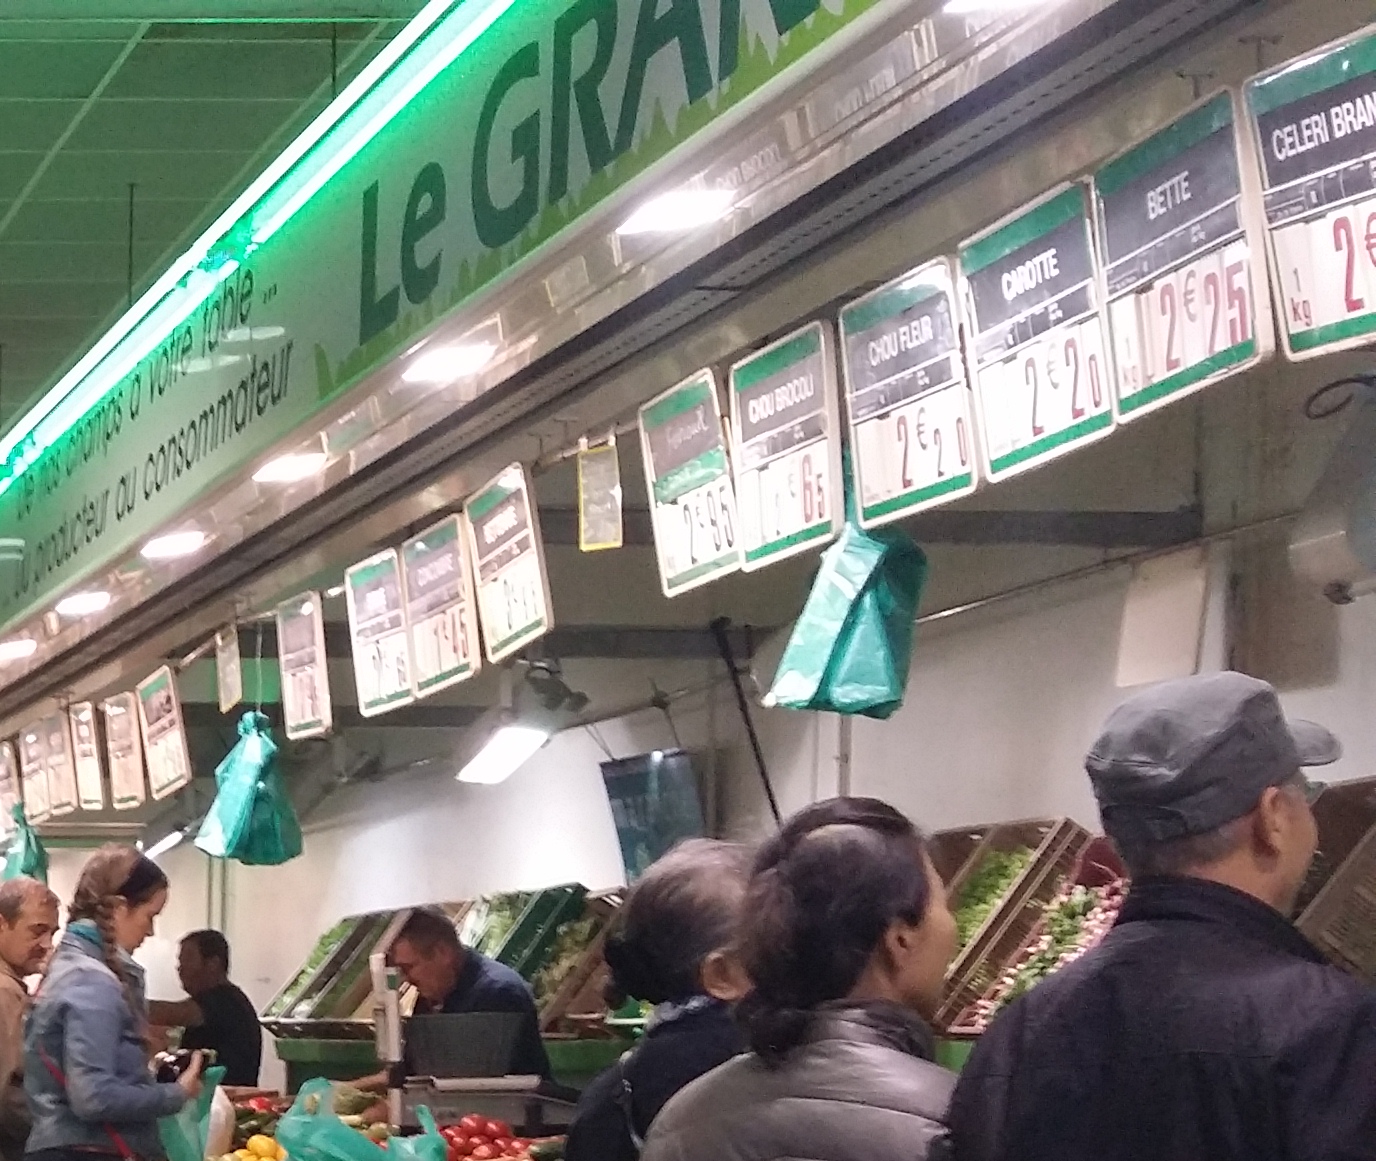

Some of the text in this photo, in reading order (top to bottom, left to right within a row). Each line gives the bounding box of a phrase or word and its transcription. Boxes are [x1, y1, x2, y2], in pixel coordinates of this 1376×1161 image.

[1272, 111, 1330, 161] CELERI
[1147, 170, 1191, 220] BETTE
[359, 161, 447, 346] Le
[1002, 248, 1059, 301] CAROTTE
[149, 325, 193, 405] votre
[868, 315, 933, 367] CHOU FLEUR
[116, 467, 137, 521] au
[143, 339, 294, 502] consommateur
[749, 392, 775, 424] CHOU
